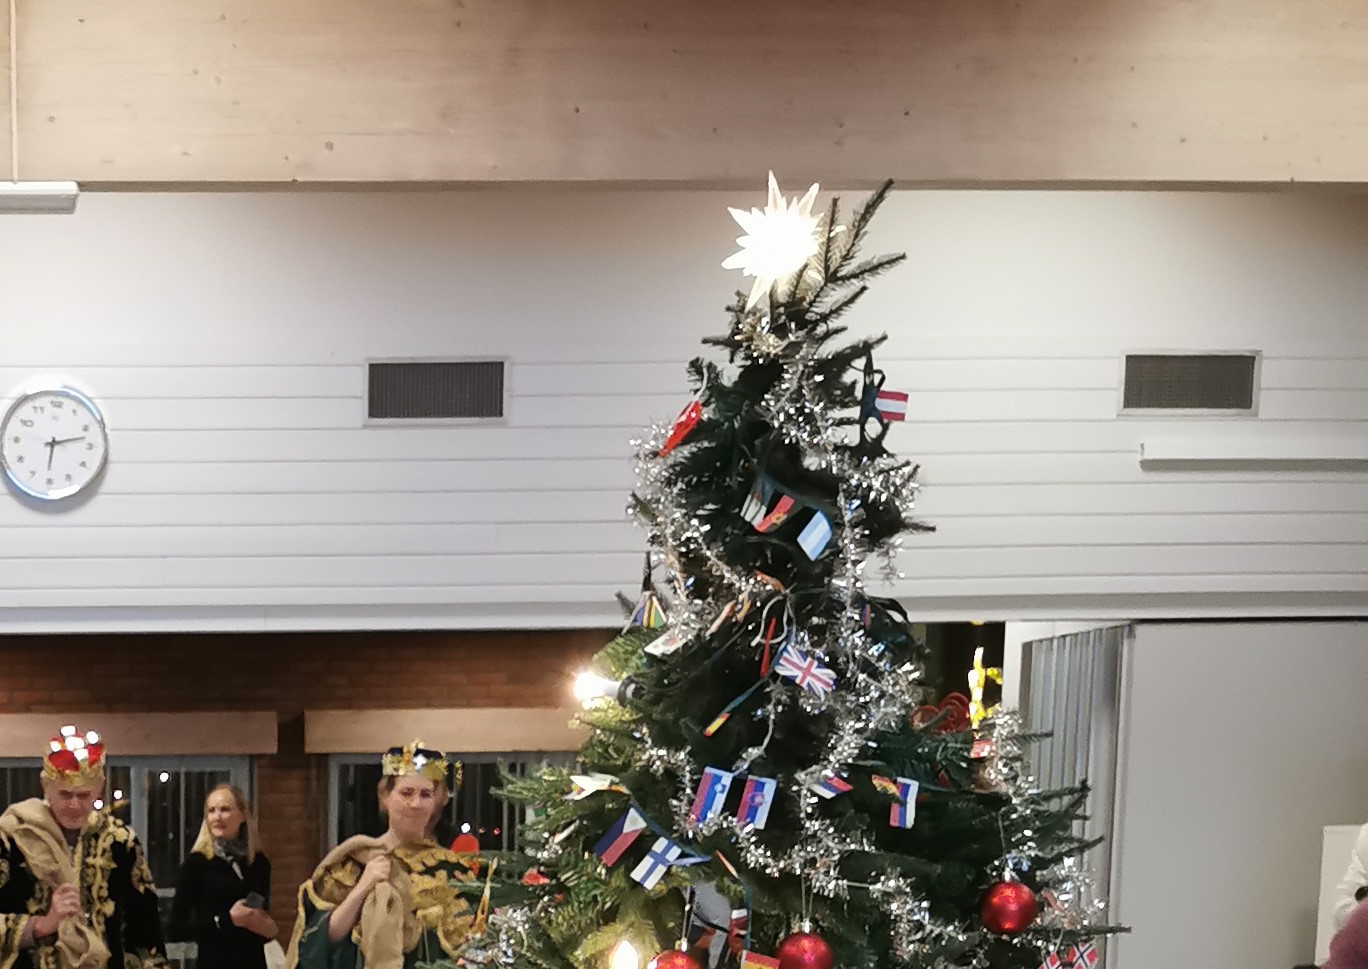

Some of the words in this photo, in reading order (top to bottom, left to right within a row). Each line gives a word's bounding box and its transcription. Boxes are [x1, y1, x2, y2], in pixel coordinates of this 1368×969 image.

[50, 400, 64, 409] 12
[32, 406, 45, 414] 11
[20, 418, 34, 428] 10
[86, 442, 94, 450] 3
